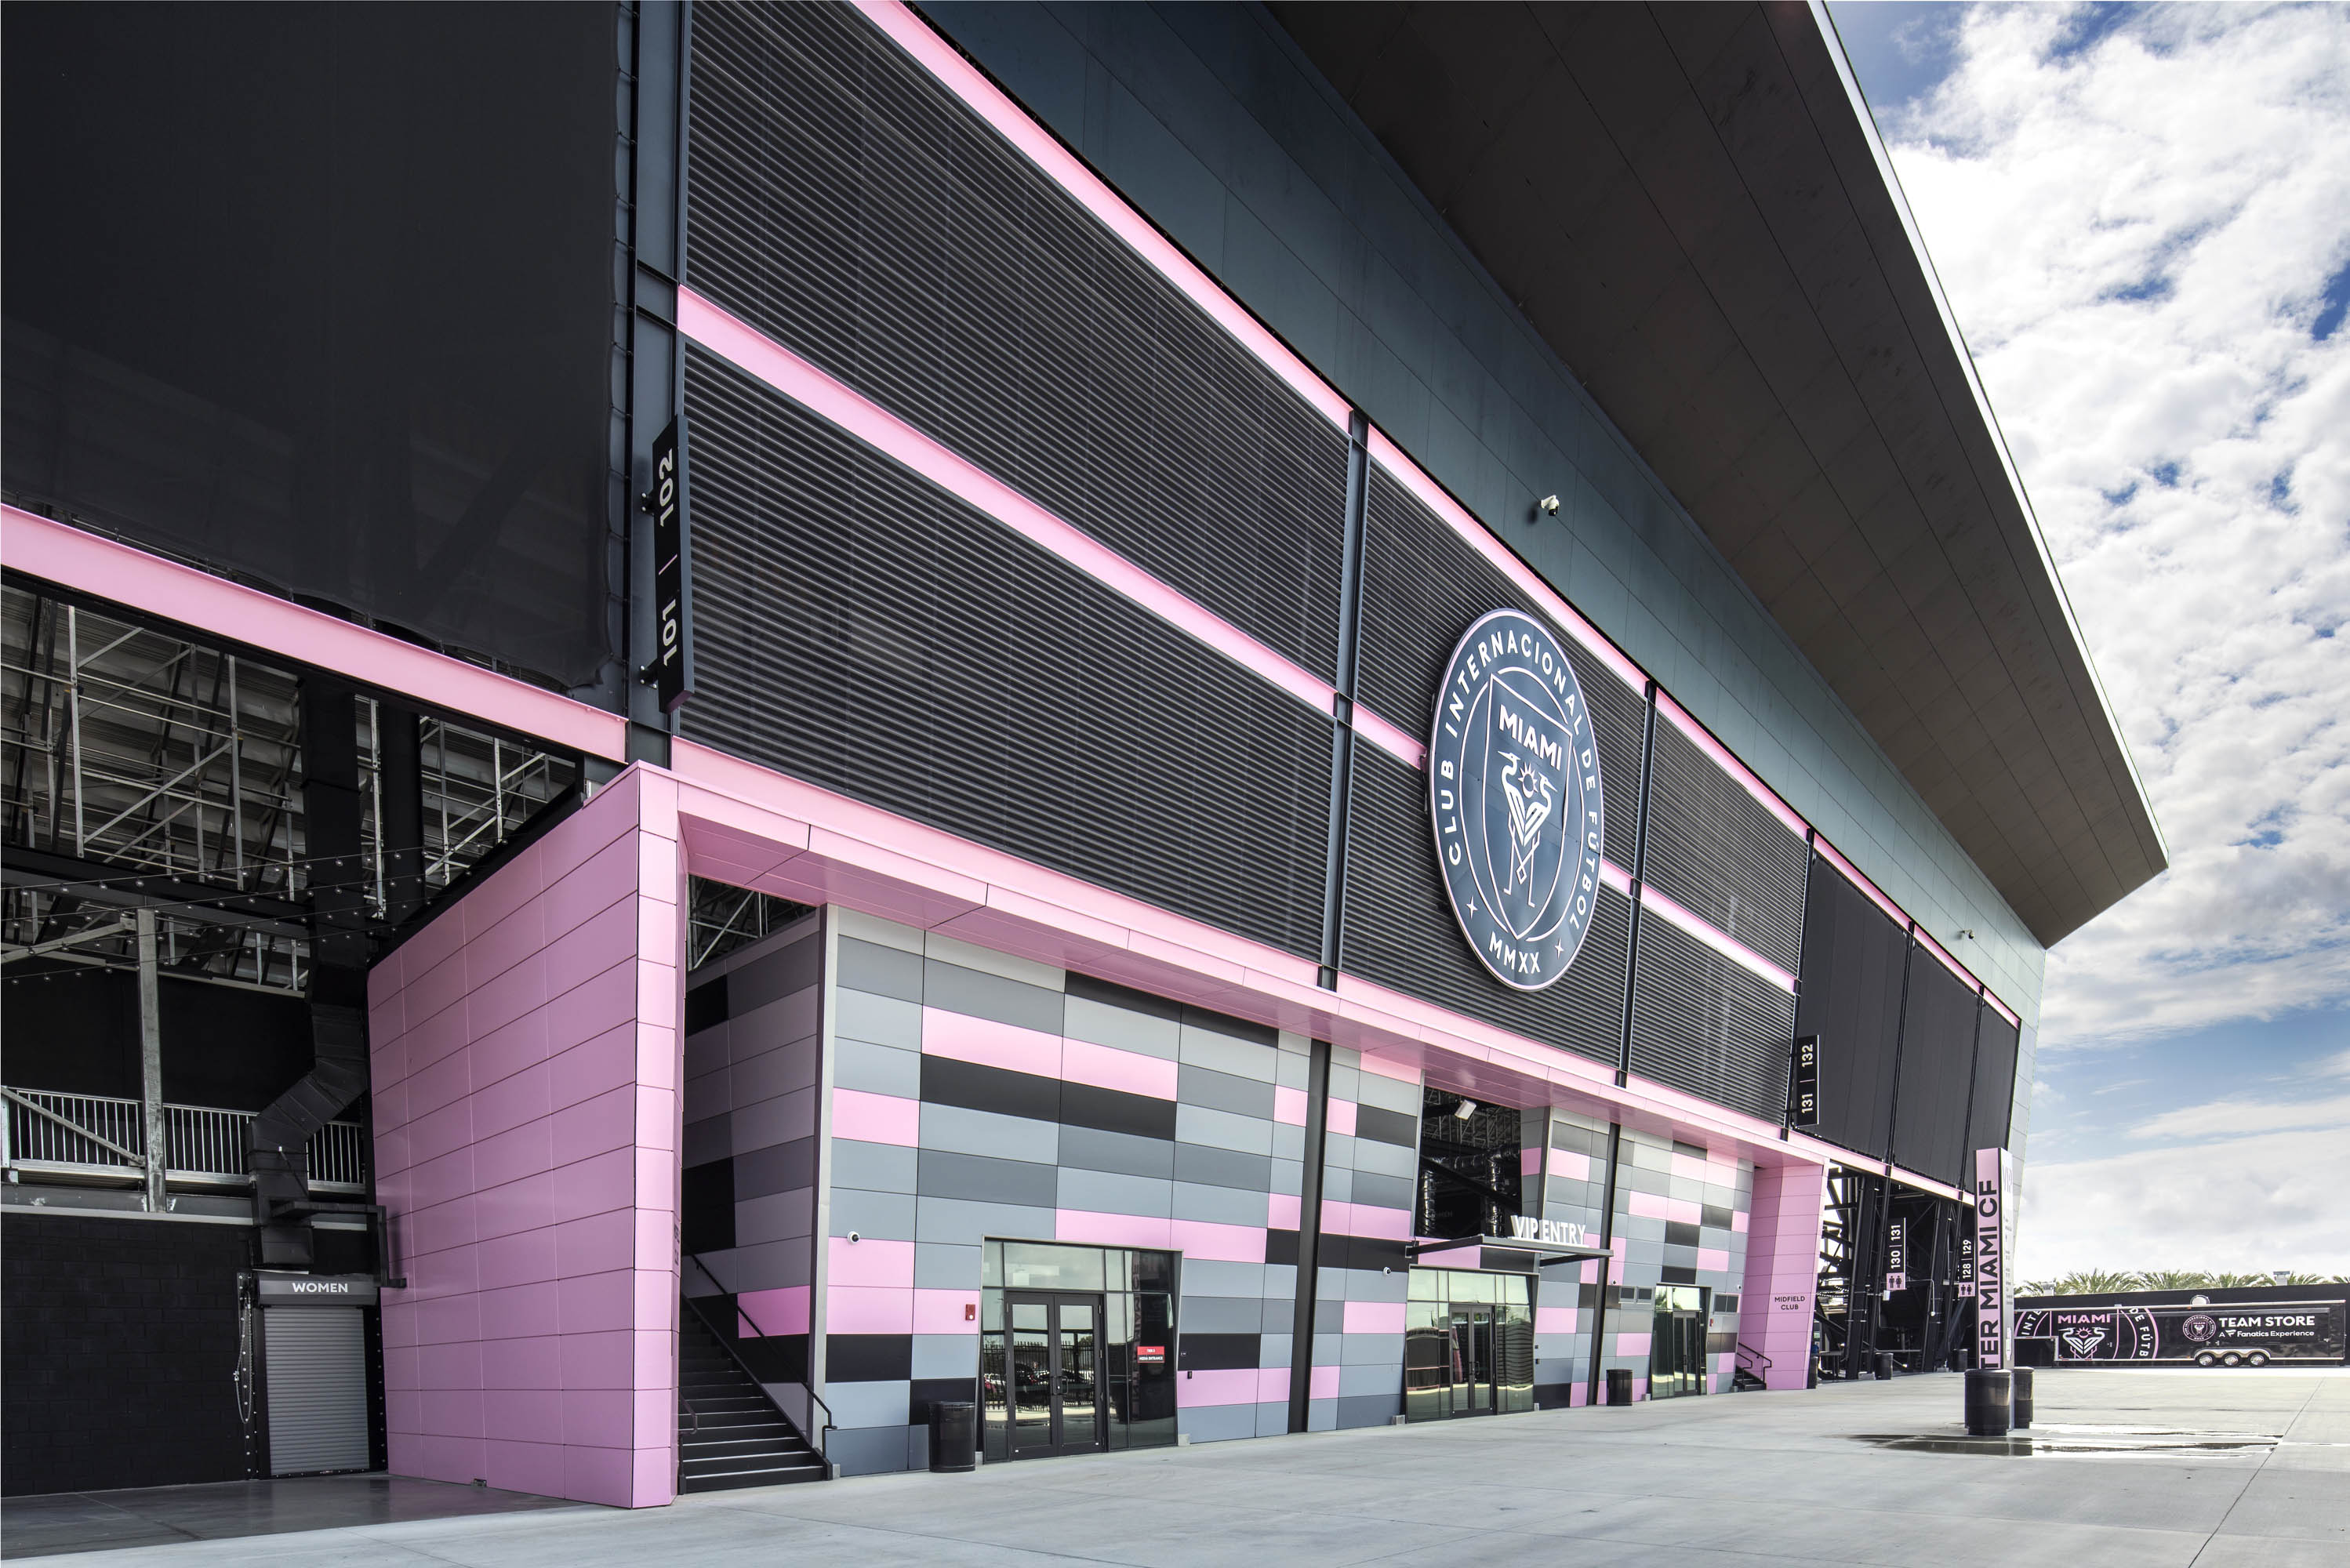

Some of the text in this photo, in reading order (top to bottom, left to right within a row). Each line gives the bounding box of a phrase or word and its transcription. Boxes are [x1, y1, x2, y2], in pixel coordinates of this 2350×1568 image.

[659, 448, 677, 666] 101 102
[1498, 704, 1563, 772] MIAMI
[1440, 630, 1600, 932] CLUB INTERNACIONAL DE FÚTBOL
[1488, 931, 1541, 974] MMXX
[1802, 1044, 1813, 1114] 131 132
[1510, 1215, 1585, 1246] VIP ENTRY
[1891, 1225, 1901, 1269] 130 131
[1963, 1240, 1971, 1279] 128 129
[1978, 1180, 1999, 1369] TER MIAMI CF
[292, 1283, 348, 1293] WOMEN
[2058, 1314, 2111, 1324] MIAMI
[2129, 1308, 2145, 1322] DE
[2218, 1317, 2261, 1327] TEAM
[2265, 1316, 2315, 1327] STORE
